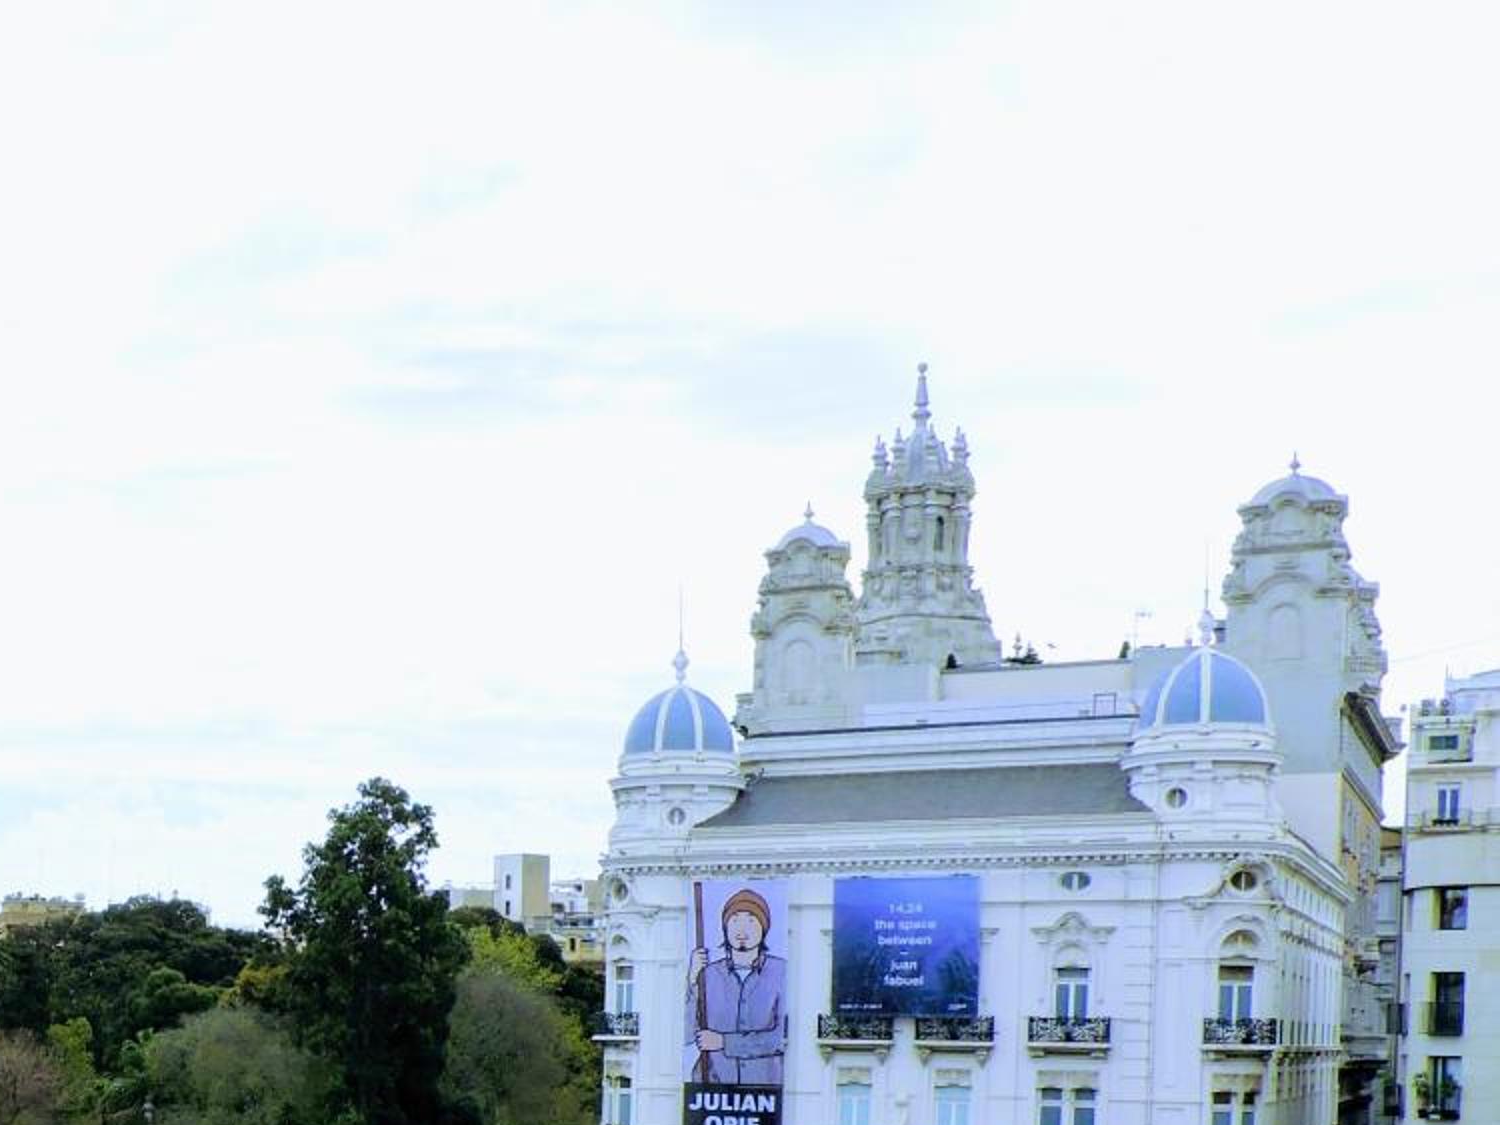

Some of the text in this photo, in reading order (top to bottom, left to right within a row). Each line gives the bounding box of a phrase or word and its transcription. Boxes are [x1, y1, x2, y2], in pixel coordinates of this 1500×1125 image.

[875, 920, 895, 930] the
[877, 935, 933, 946] between
[890, 960, 917, 972] juan
[884, 975, 925, 987] fabuel
[688, 1092, 776, 1113] JULIAN
